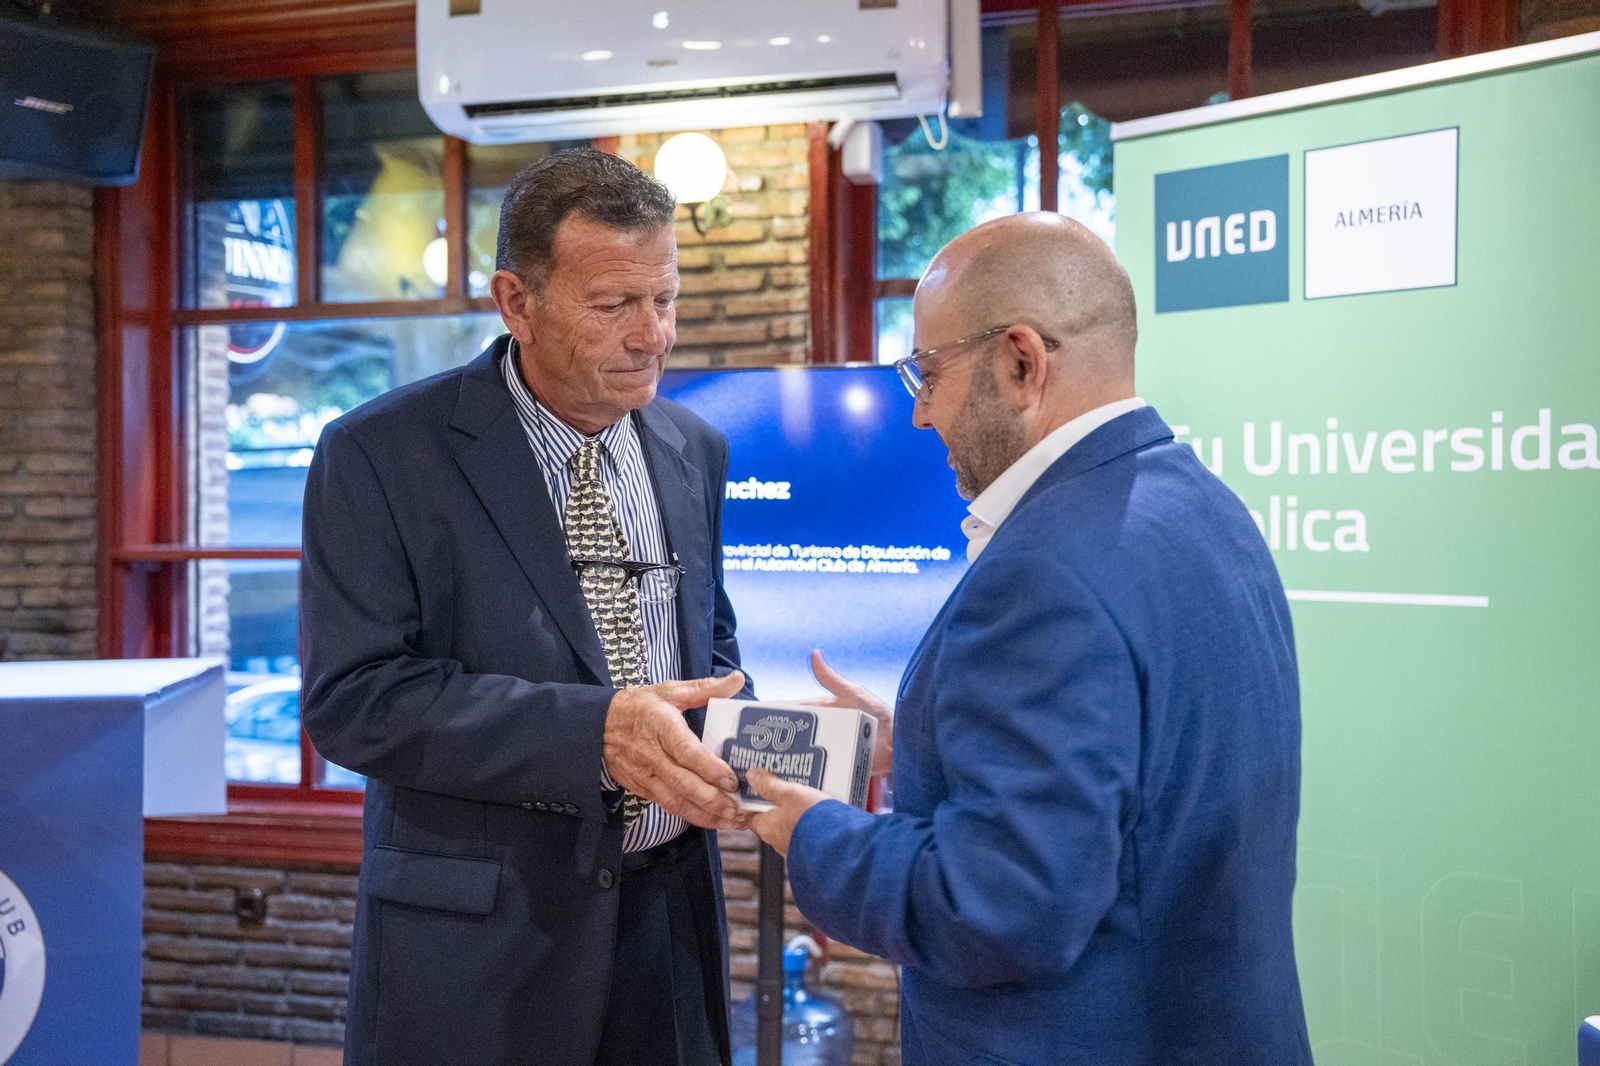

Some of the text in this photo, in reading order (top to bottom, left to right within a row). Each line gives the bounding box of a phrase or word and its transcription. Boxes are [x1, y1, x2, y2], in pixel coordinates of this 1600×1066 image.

[1334, 200, 1423, 229] ALMERÍA
[1166, 209, 1277, 263] UNED
[754, 557, 817, 572] Automóvil
[817, 558, 847, 573] Club
[847, 559, 866, 573] de
[772, 543, 790, 557] de
[790, 543, 841, 558] Turismo
[842, 544, 861, 559] de
[861, 545, 930, 560] Diputación
[931, 545, 951, 560] de
[728, 745, 814, 777] ANIVERSARIO
